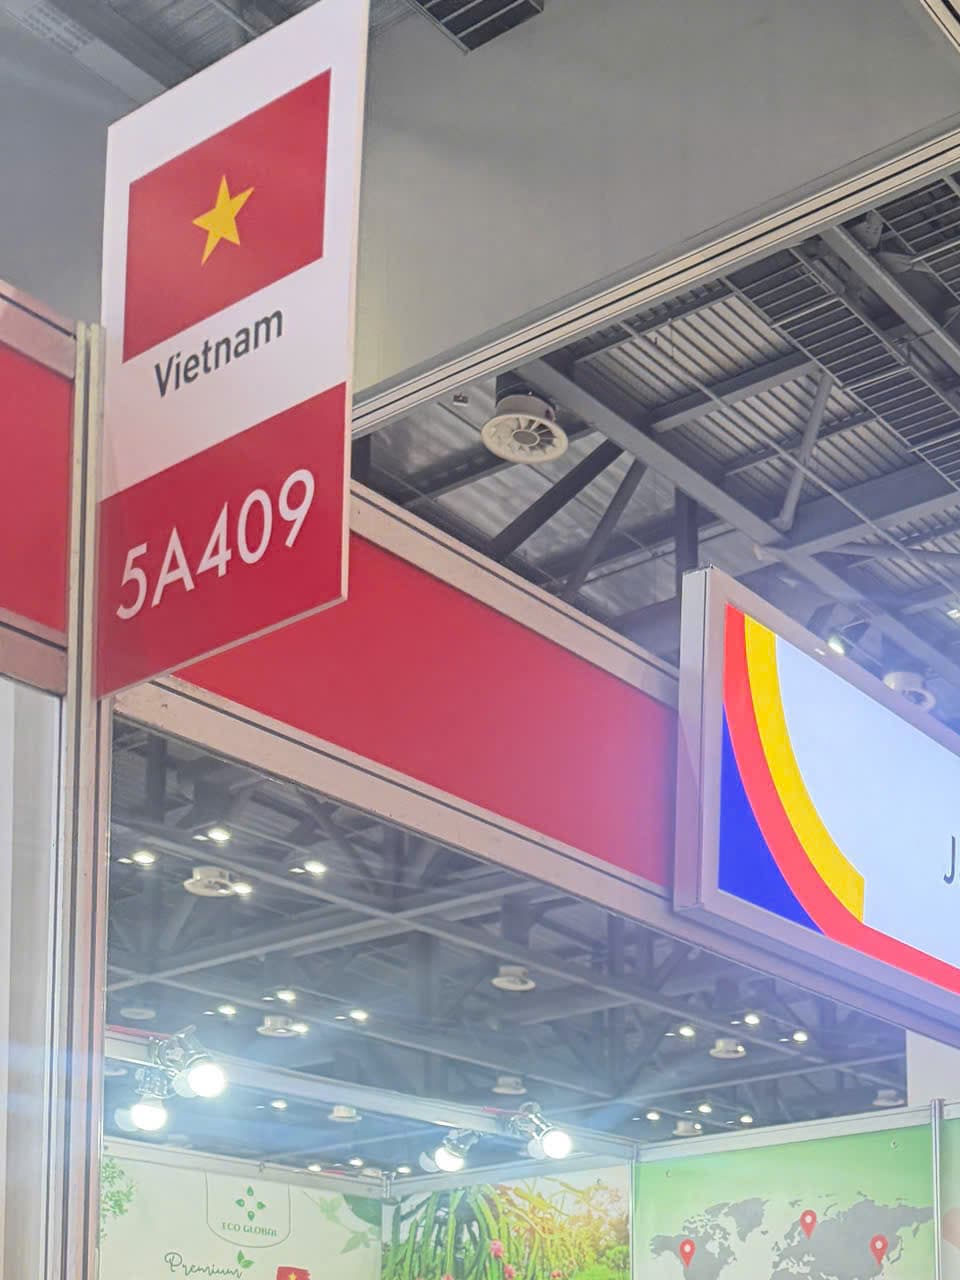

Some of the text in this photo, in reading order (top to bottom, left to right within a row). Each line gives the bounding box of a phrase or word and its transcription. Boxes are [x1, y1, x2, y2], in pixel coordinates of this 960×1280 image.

[154, 309, 283, 397] Vietnam
[116, 469, 316, 619] 5A409
[222, 1222, 241, 1232] ECO
[164, 1251, 243, 1279] Premium
